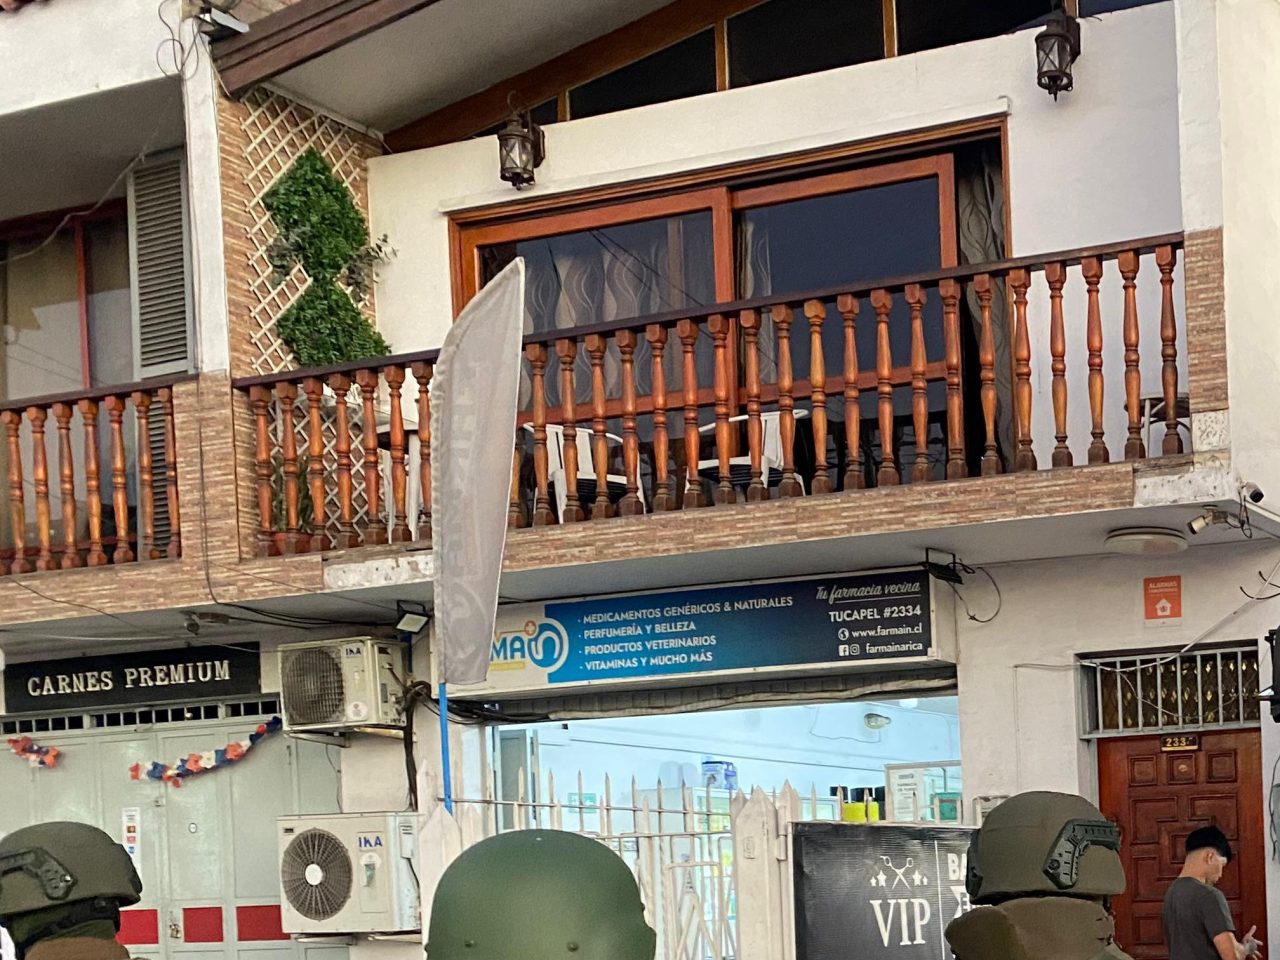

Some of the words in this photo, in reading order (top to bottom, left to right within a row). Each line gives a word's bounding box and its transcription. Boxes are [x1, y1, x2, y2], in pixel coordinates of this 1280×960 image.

[816, 586, 828, 600] Tu
[828, 584, 882, 605] farmacia
[884, 581, 920, 595] vecina
[583, 608, 661, 624] MEDICAMENTOS
[664, 602, 721, 617] GENÉRICOS
[724, 603, 731, 612] &
[734, 596, 793, 610] NATURALES
[829, 610, 880, 622] TUCAPEL
[883, 604, 922, 618] #2334
[584, 622, 642, 640] PERFUMERÍA
[645, 625, 653, 635] Y
[655, 621, 696, 634] BELLEZA
[851, 622, 922, 638] www.farmain.cl
[584, 641, 642, 655] PRODUCTOS
[645, 635, 717, 650] VETERINARIOS
[865, 641, 923, 654] farmainarica
[585, 657, 638, 671] VITAMINAS
[640, 657, 648, 667] Y
[650, 654, 688, 666] MUCHO
[690, 649, 713, 663] MÁS
[27, 670, 113, 697] CARNES
[124, 660, 231, 689] PREMIUM
[1166, 736, 1193, 746] 233
[869, 899, 931, 947] VIP
